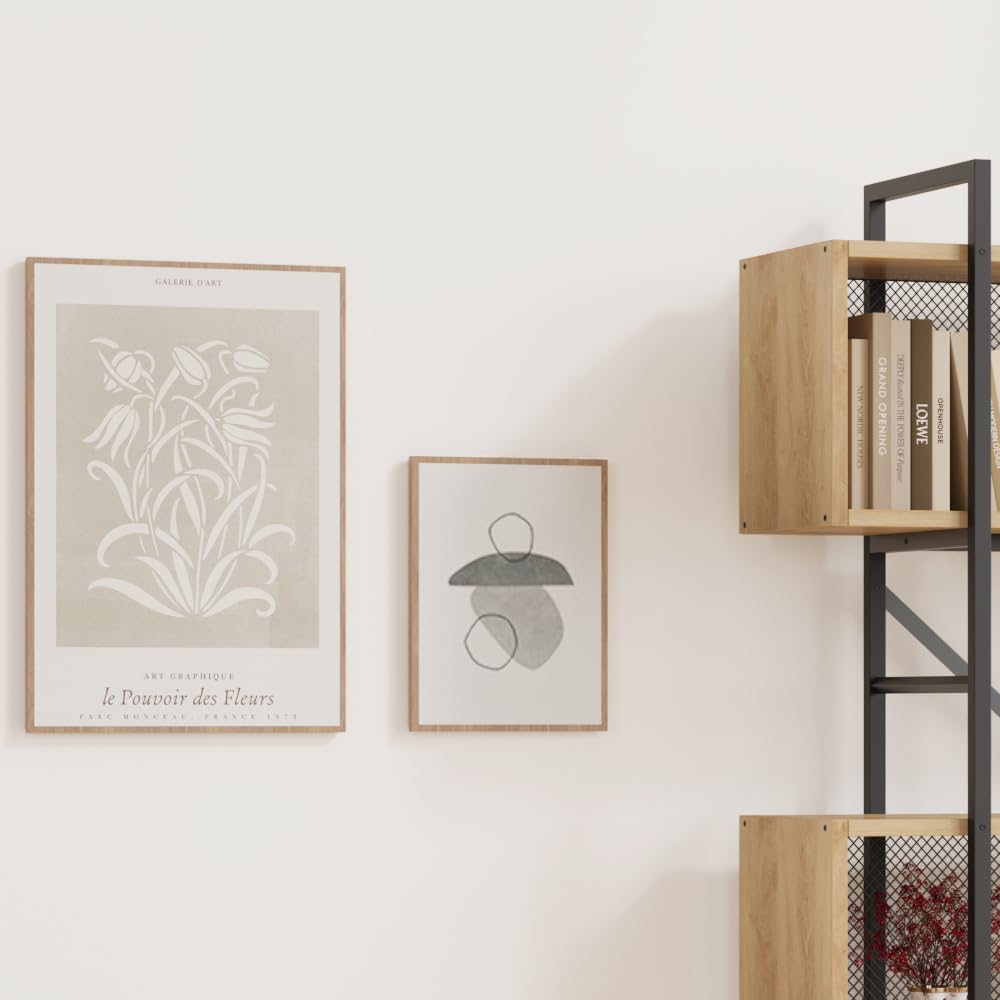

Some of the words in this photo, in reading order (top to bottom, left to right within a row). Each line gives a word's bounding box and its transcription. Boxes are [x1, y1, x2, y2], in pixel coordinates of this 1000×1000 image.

[155, 278, 193, 287] GALERIE
[197, 279, 222, 288] D'ART
[878, 357, 887, 398] GRAND
[878, 402, 887, 456] OPENING
[916, 403, 929, 445] LOEWE
[144, 672, 164, 680] ART
[170, 672, 234, 681] GRAPHIQUE
[102, 686, 115, 706] le
[121, 688, 188, 706] Pouvoir
[192, 687, 217, 706] des
[223, 687, 275, 706] Fleurs
